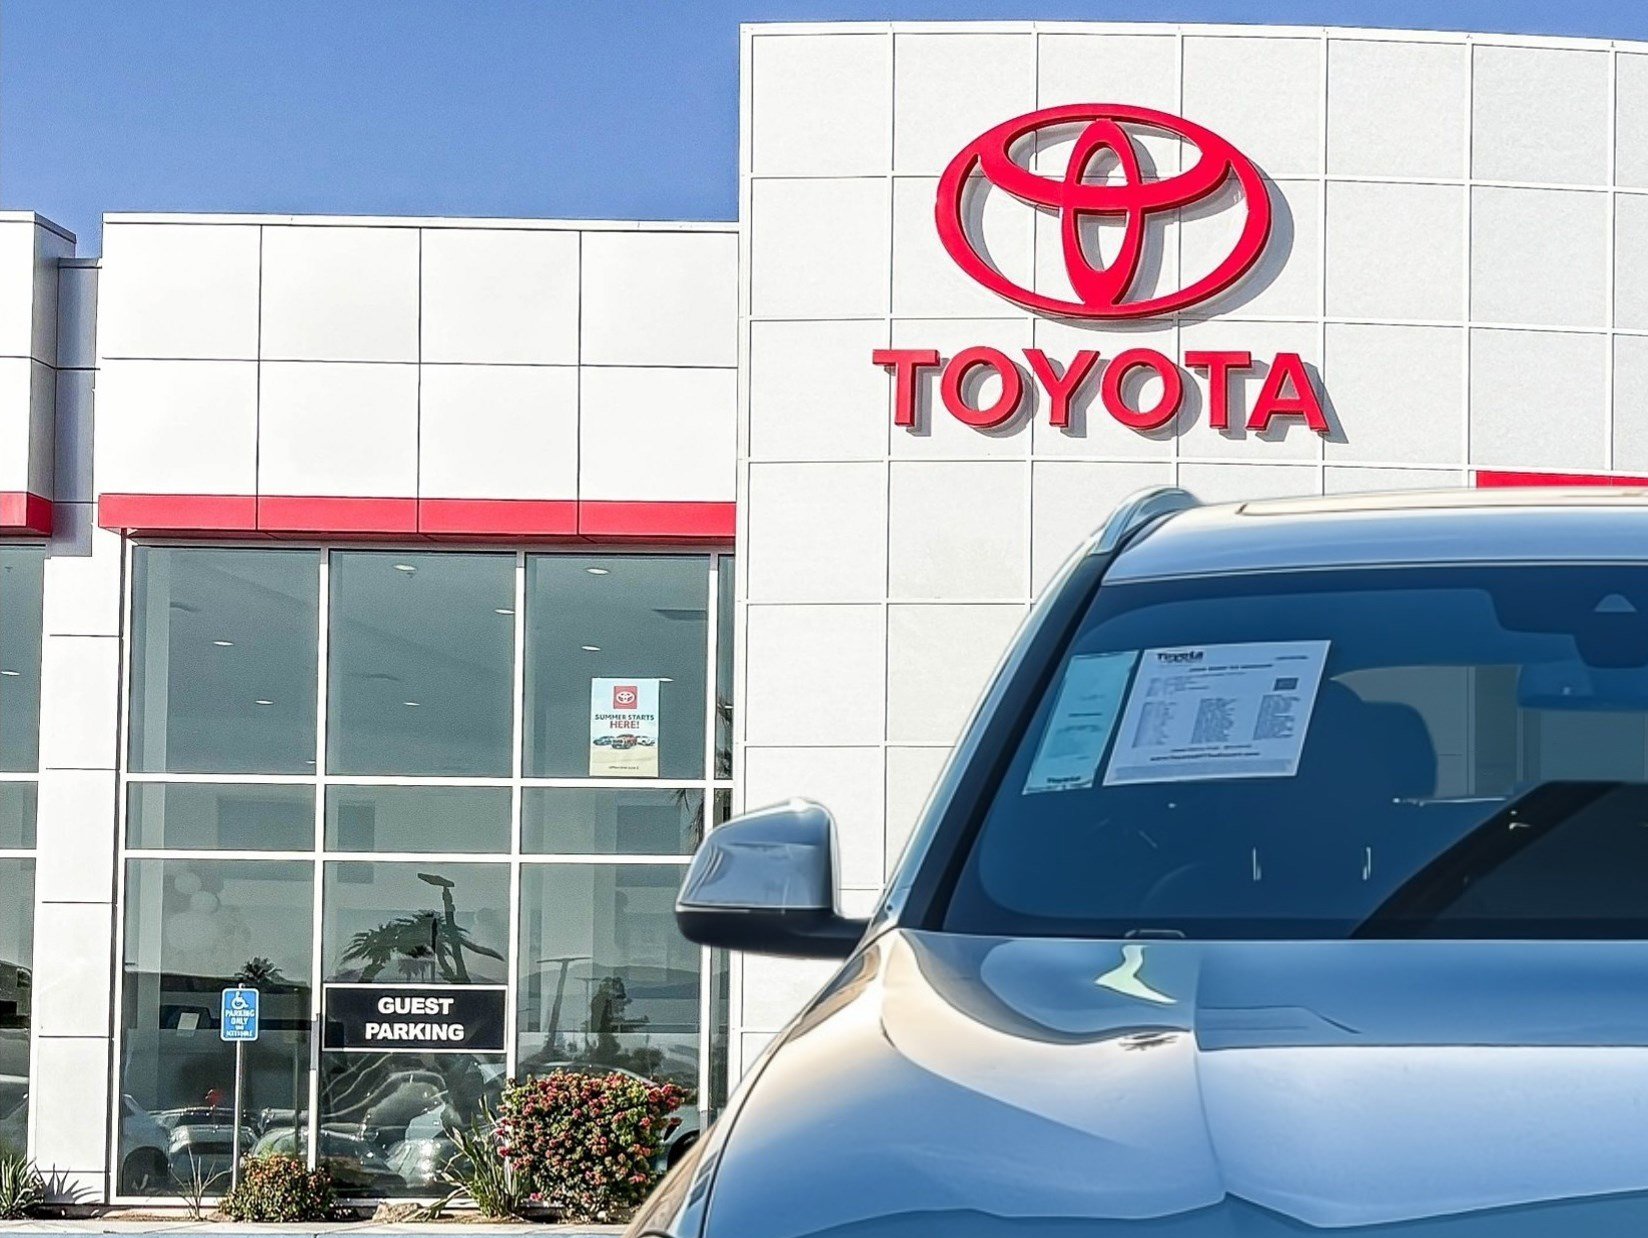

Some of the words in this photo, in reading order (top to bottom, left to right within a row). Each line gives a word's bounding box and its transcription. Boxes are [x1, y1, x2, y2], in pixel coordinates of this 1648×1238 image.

[872, 346, 1330, 432] TOYOTA
[610, 721, 640, 729] HERE!
[378, 997, 454, 1014] GUEST
[365, 1023, 464, 1041] PARKING
